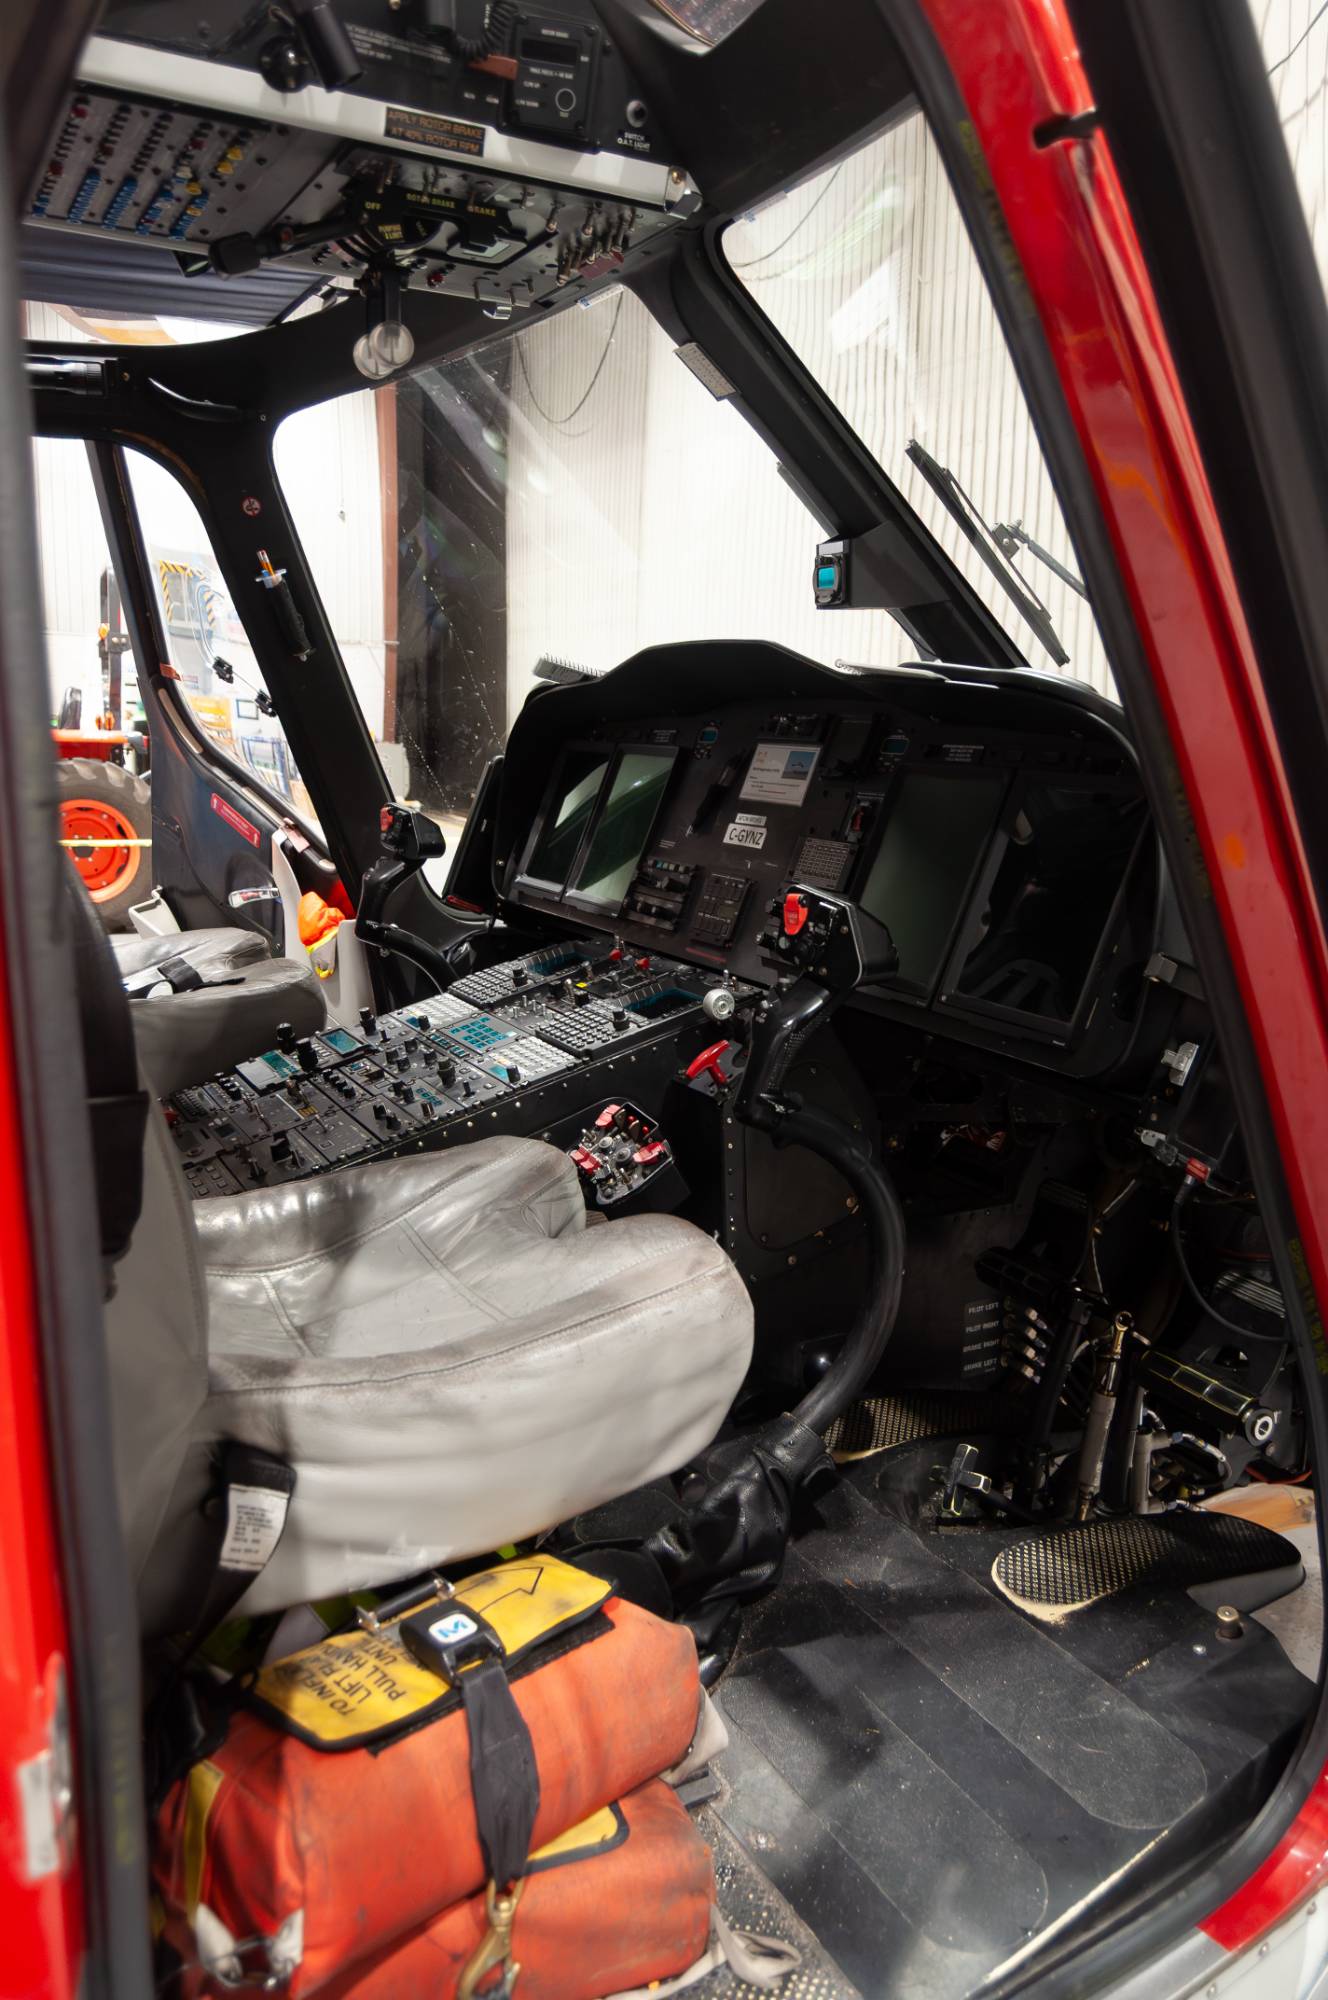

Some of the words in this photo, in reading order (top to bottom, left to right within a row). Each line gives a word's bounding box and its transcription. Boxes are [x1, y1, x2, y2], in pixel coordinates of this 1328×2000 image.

[452, 123, 482, 138] BRAKE
[729, 827, 763, 846] C-GYNZ
[333, 1674, 372, 1704] LIFT
[367, 1664, 407, 1702] PULL
[329, 1698, 357, 1716] TO
